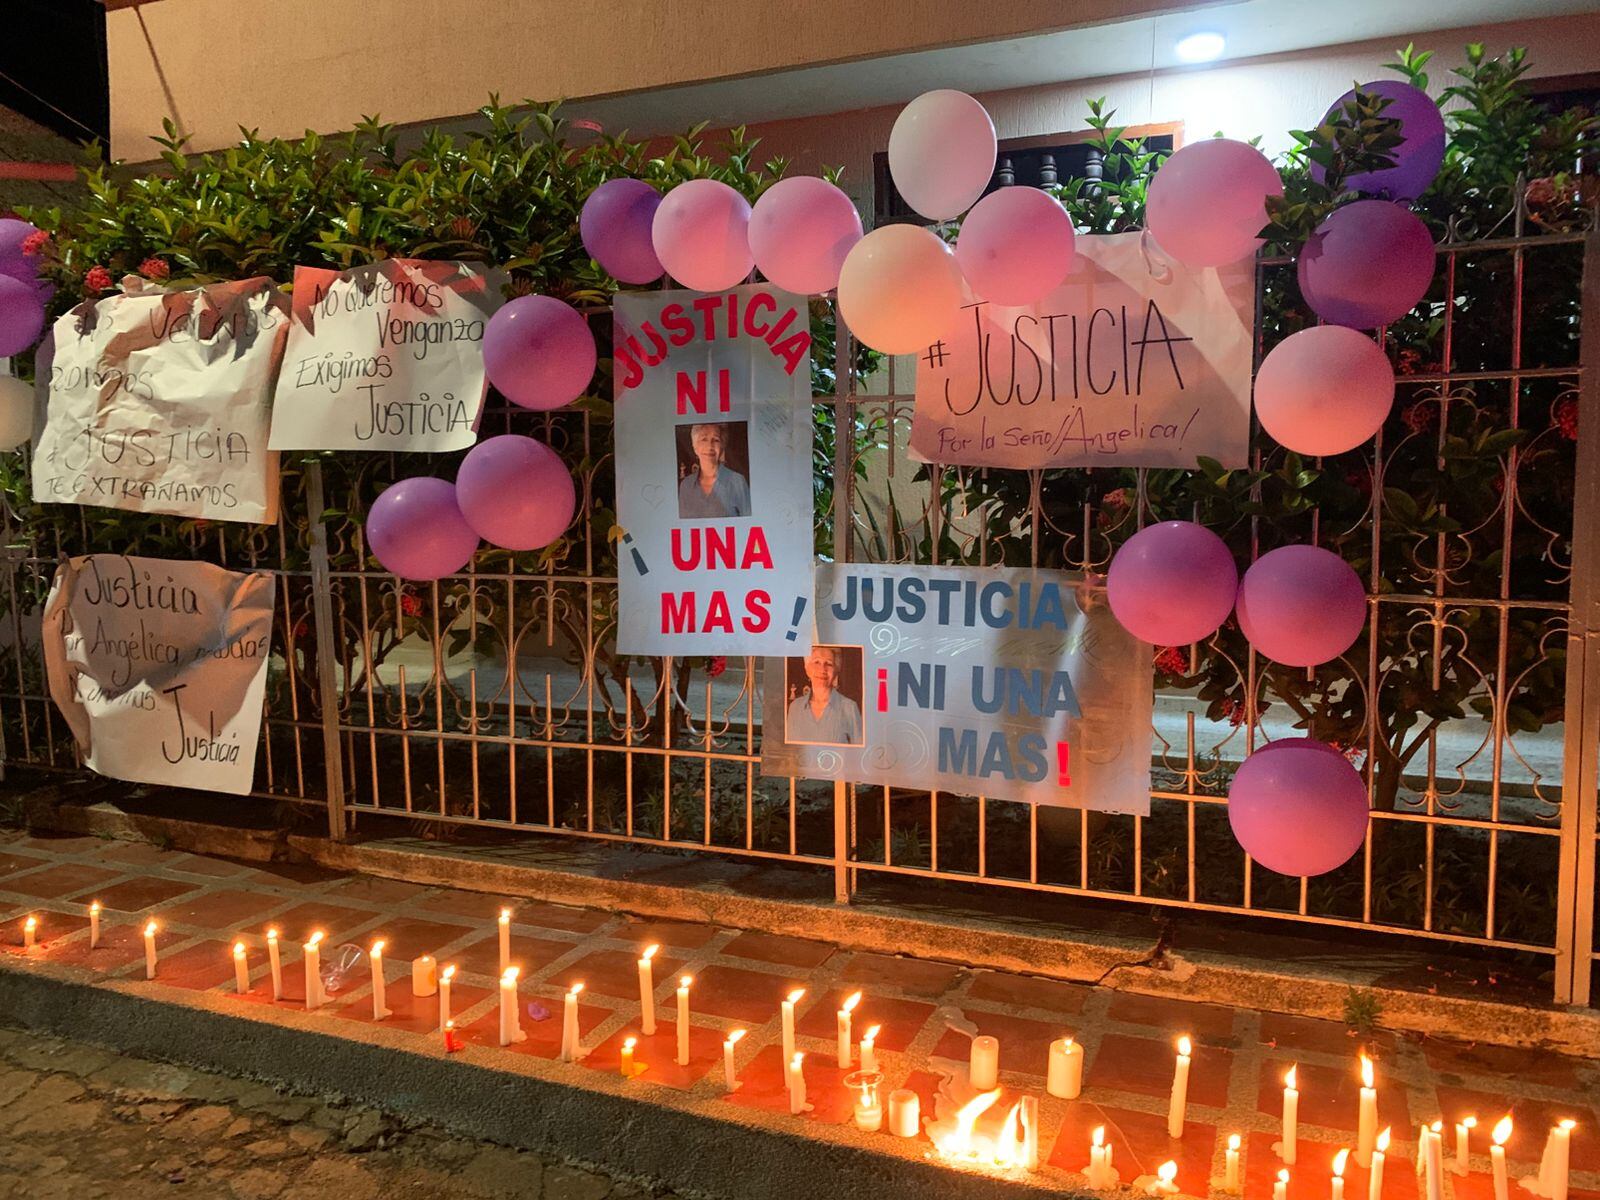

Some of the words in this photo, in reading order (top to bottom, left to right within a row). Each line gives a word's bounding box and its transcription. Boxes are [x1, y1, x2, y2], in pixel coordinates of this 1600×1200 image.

[312, 284, 339, 320] No
[376, 309, 484, 360] Venganza
[614, 293, 812, 389] JUSTICIA
[296, 352, 393, 393] Exigimos
[676, 369, 731, 415] NI
[937, 427, 971, 455] Por
[981, 416, 996, 452] la
[82, 556, 202, 616] Justicia
[831, 575, 1068, 632] JUSTICIA
[971, 665, 1082, 719] UNA
[162, 683, 241, 766] Justicia
